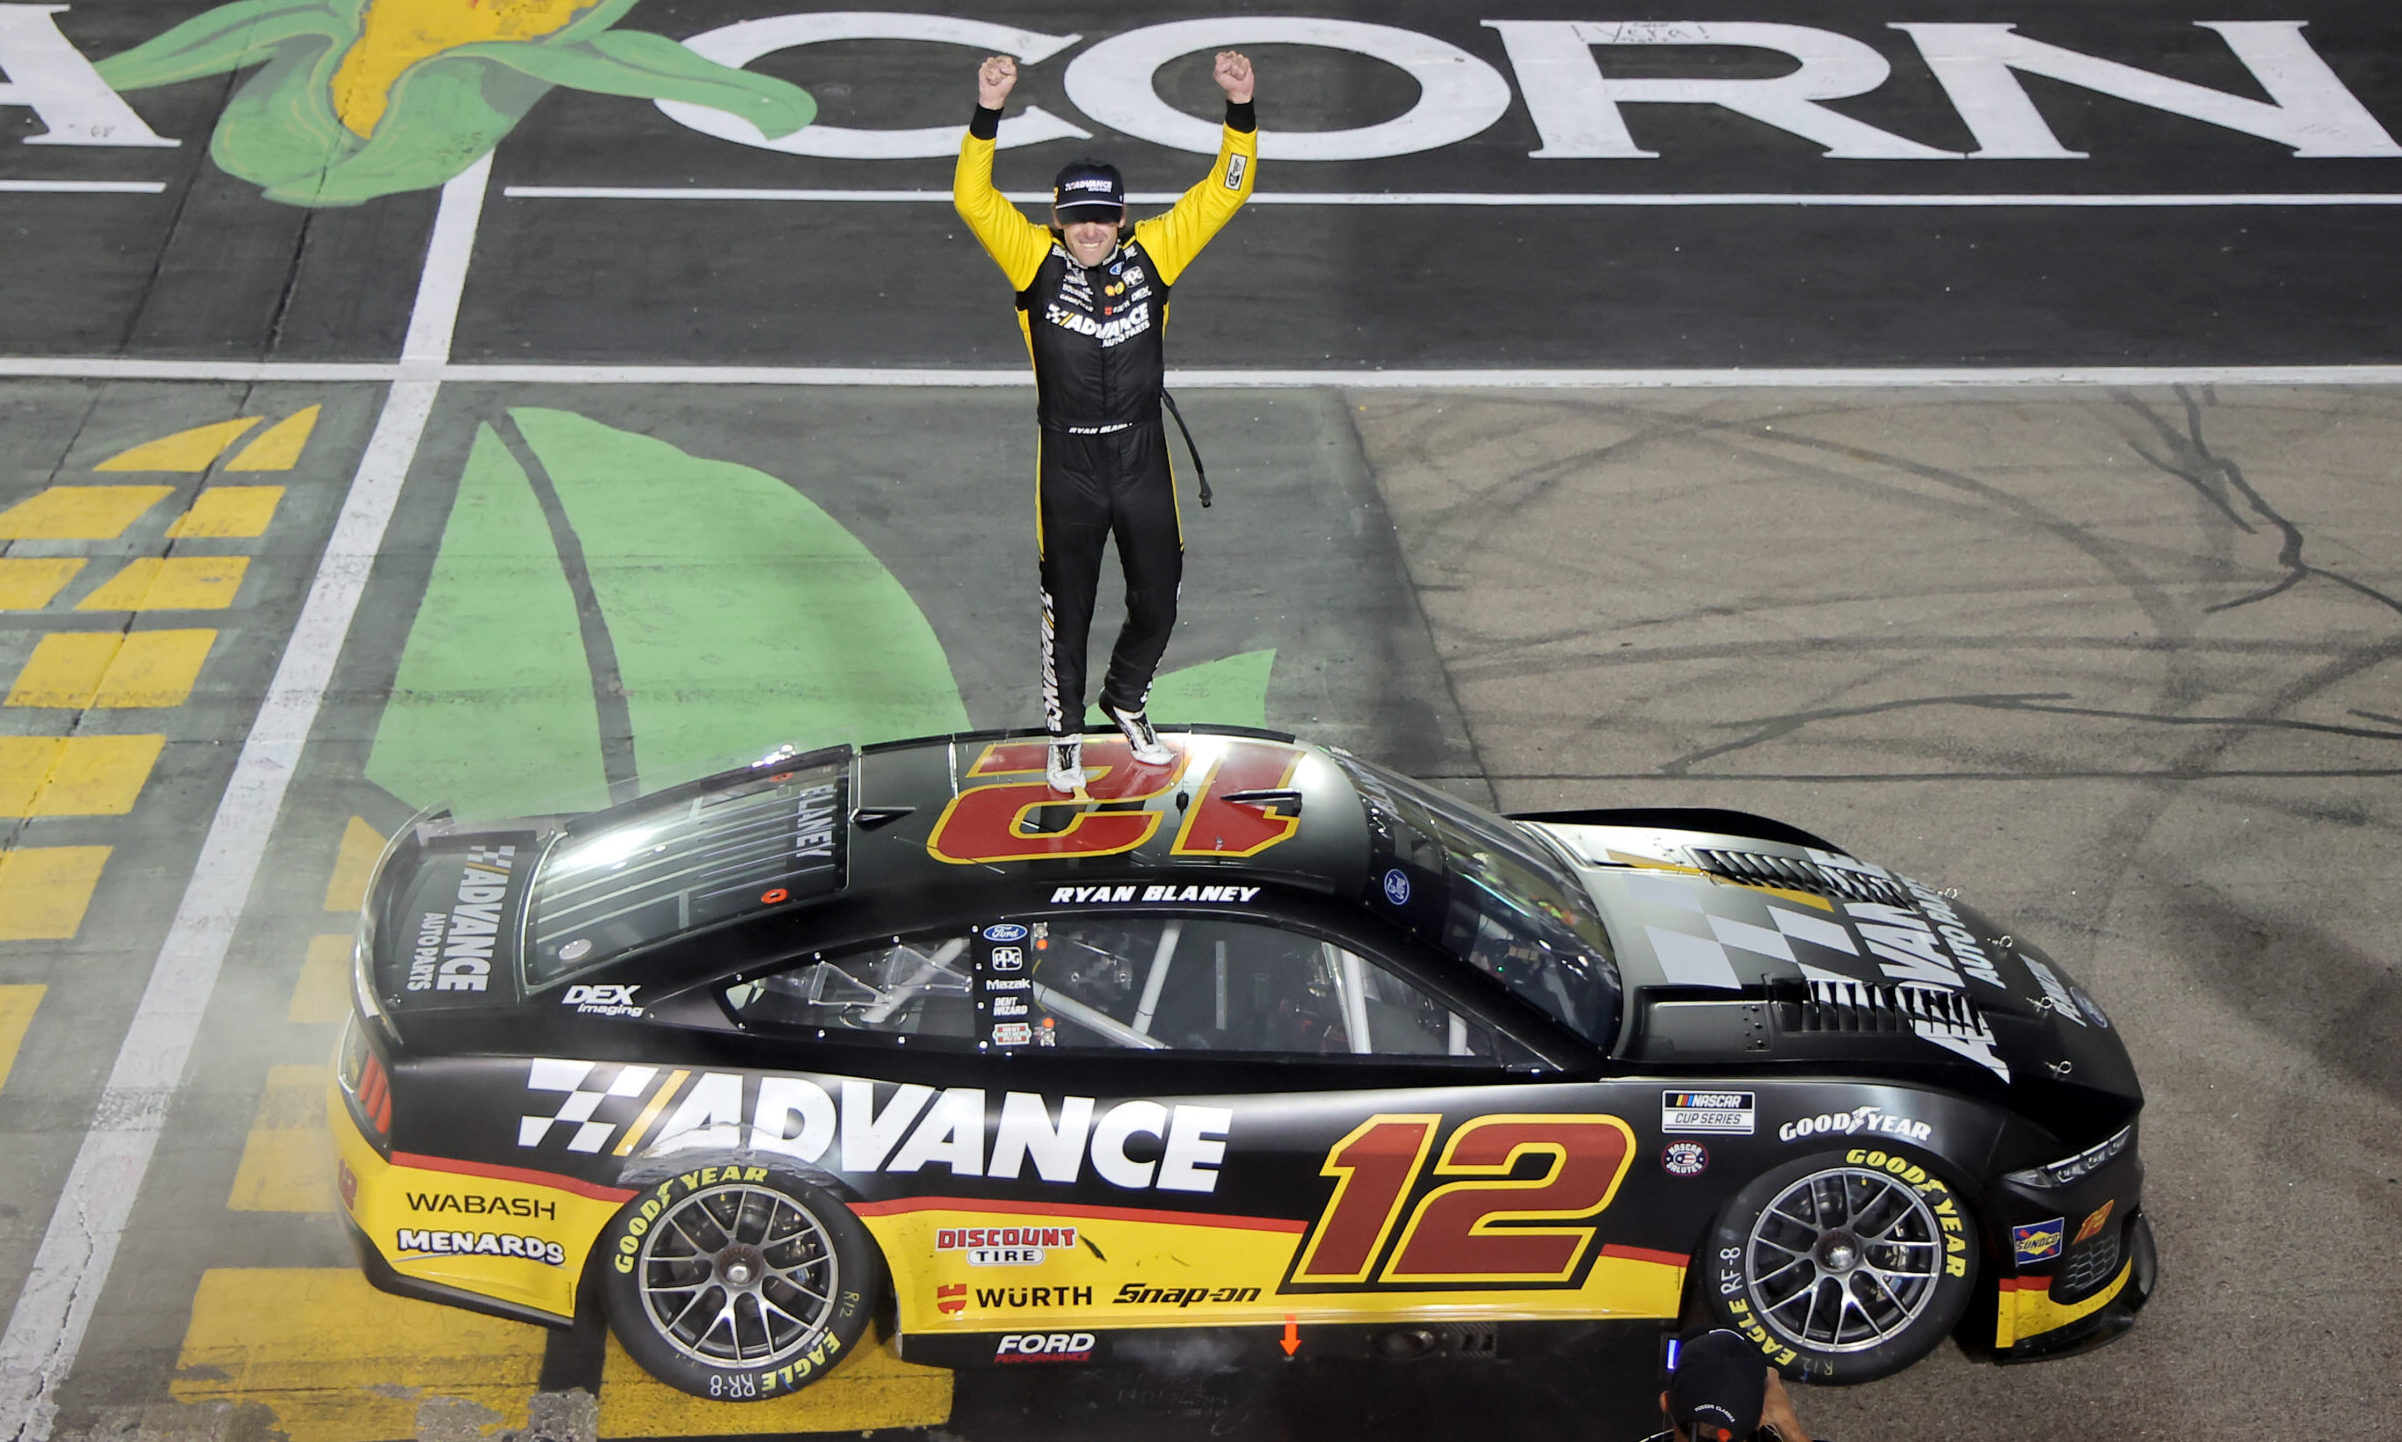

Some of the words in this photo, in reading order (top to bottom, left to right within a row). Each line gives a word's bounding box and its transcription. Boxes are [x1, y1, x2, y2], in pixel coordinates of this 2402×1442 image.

[653, 12, 2402, 160] CORN
[1063, 302, 1149, 339] ADVANCE
[1102, 333, 1125, 348] AUTO
[796, 784, 838, 858] BLANEY
[1051, 886, 1137, 903] RYAN
[1142, 885, 1261, 902] BLANEY
[417, 912, 447, 947] AUTO
[436, 866, 509, 992] ADVANCE
[989, 926, 1021, 939] Ford
[407, 946, 439, 991] PARTS
[993, 949, 1021, 968] PPG
[986, 978, 1031, 990] Mazak
[561, 984, 641, 1005] DEX
[994, 997, 1018, 1006] DENT
[993, 1005, 1028, 1016] WIZARD
[1692, 1095, 1741, 1108] NASCAR
[1675, 1113, 1699, 1124] CUP
[1700, 1113, 1741, 1125] SERIES
[642, 1071, 1233, 1193] ADVANCE
[1667, 1143, 1703, 1156] NASCAR
[1666, 1161, 1703, 1174] SALUTES
[406, 1193, 555, 1220] WABASH
[1290, 1113, 1637, 1283] 12
[398, 1229, 566, 1265] MENARDS
[937, 1228, 1076, 1248] DISCOUNT
[2015, 1232, 2060, 1251] SUNOCO
[975, 1250, 1036, 1263] TIRE
[1720, 1247, 1743, 1294] RF-8
[1113, 1283, 1261, 1308] Snap-on
[1728, 1298, 1797, 1366] EAGLE
[997, 1334, 1095, 1354] FORD
[761, 1331, 841, 1391] EAGLE
[993, 1352, 1091, 1364] PERFORMANCE
[710, 1373, 756, 1398] RR-8
